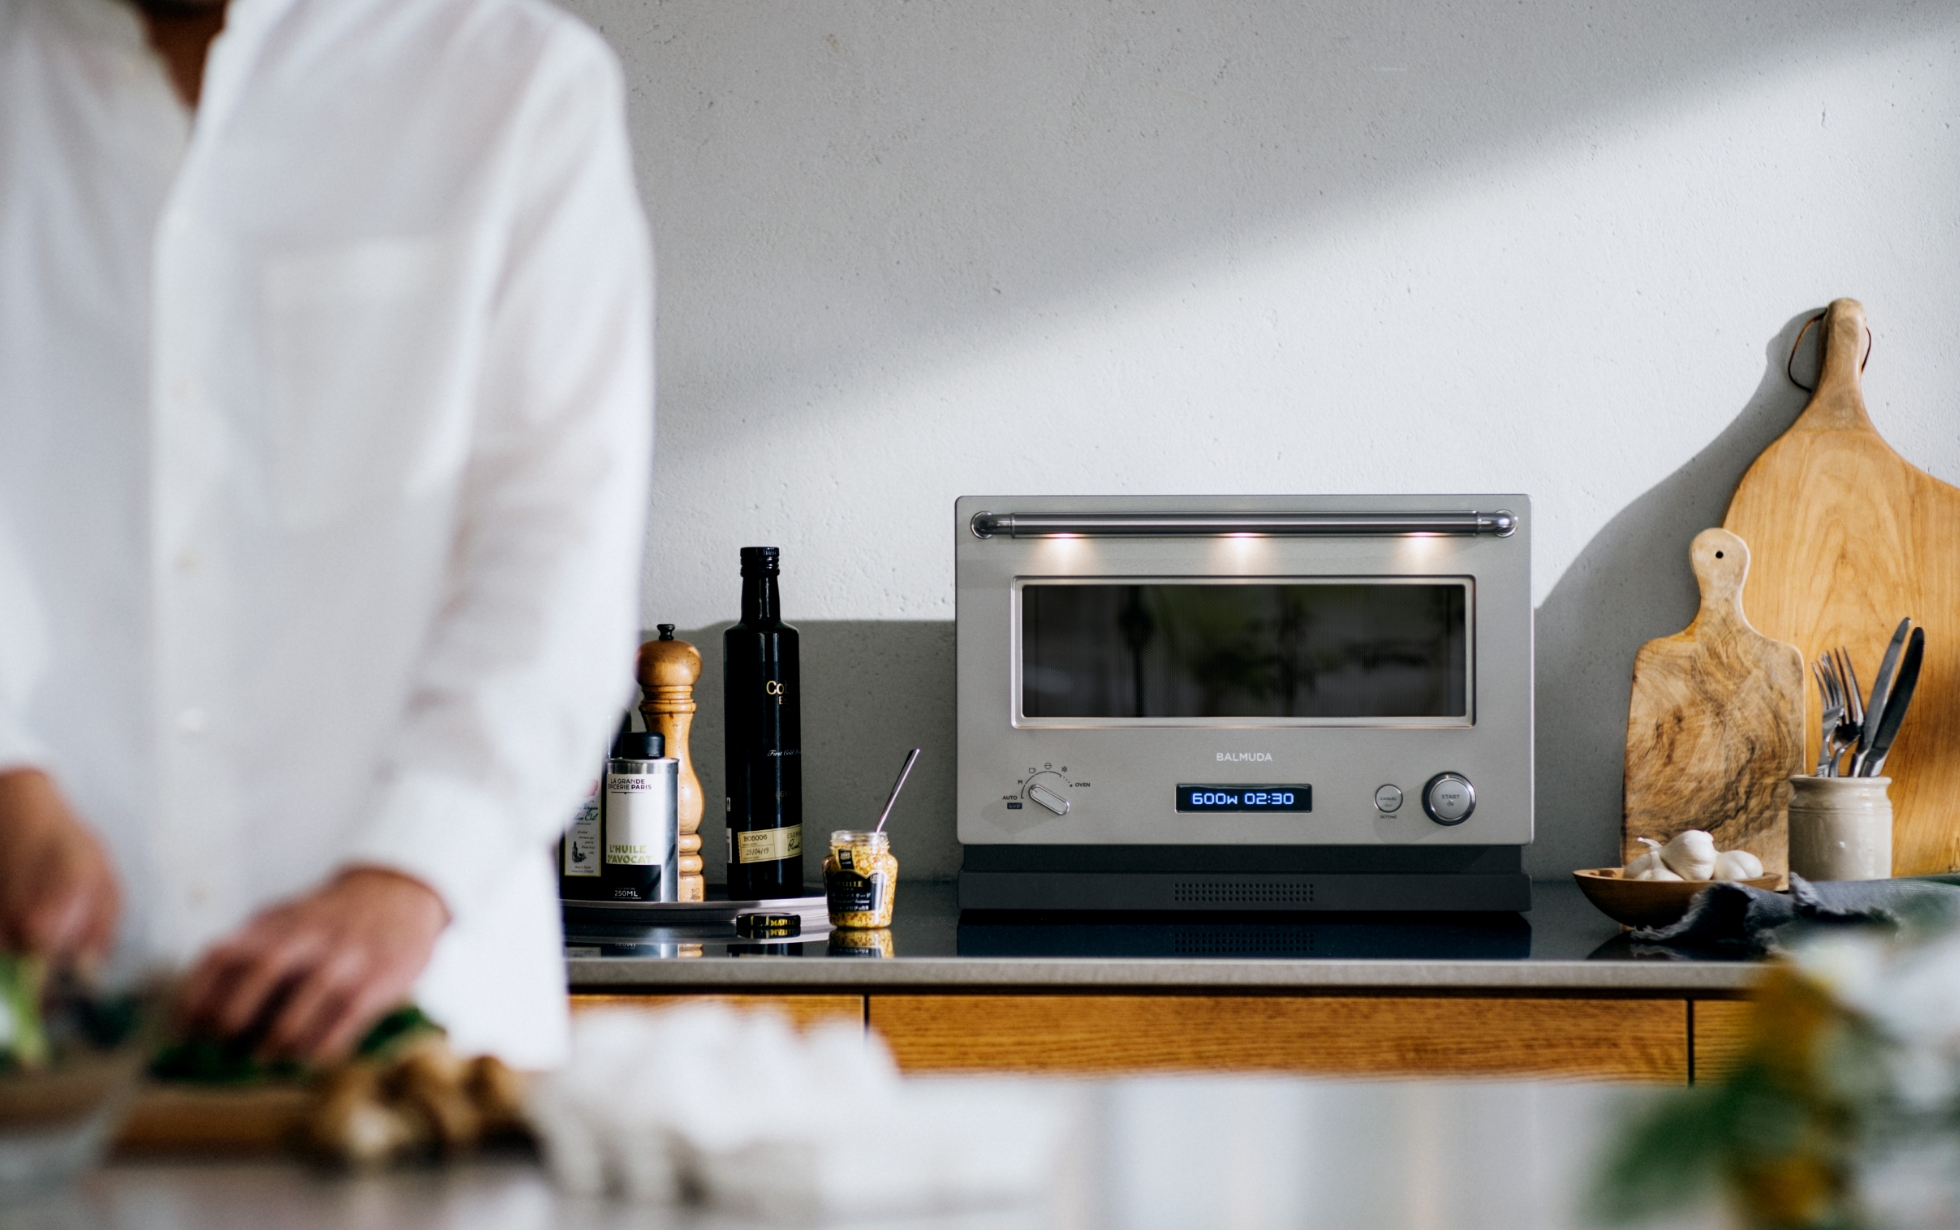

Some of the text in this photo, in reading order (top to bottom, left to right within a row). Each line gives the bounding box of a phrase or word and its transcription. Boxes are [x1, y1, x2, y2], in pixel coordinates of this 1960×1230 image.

[1216, 752, 1273, 762] BALMUDA
[1244, 793, 1294, 805] 02:30
[609, 844, 647, 854] L'HUILE
